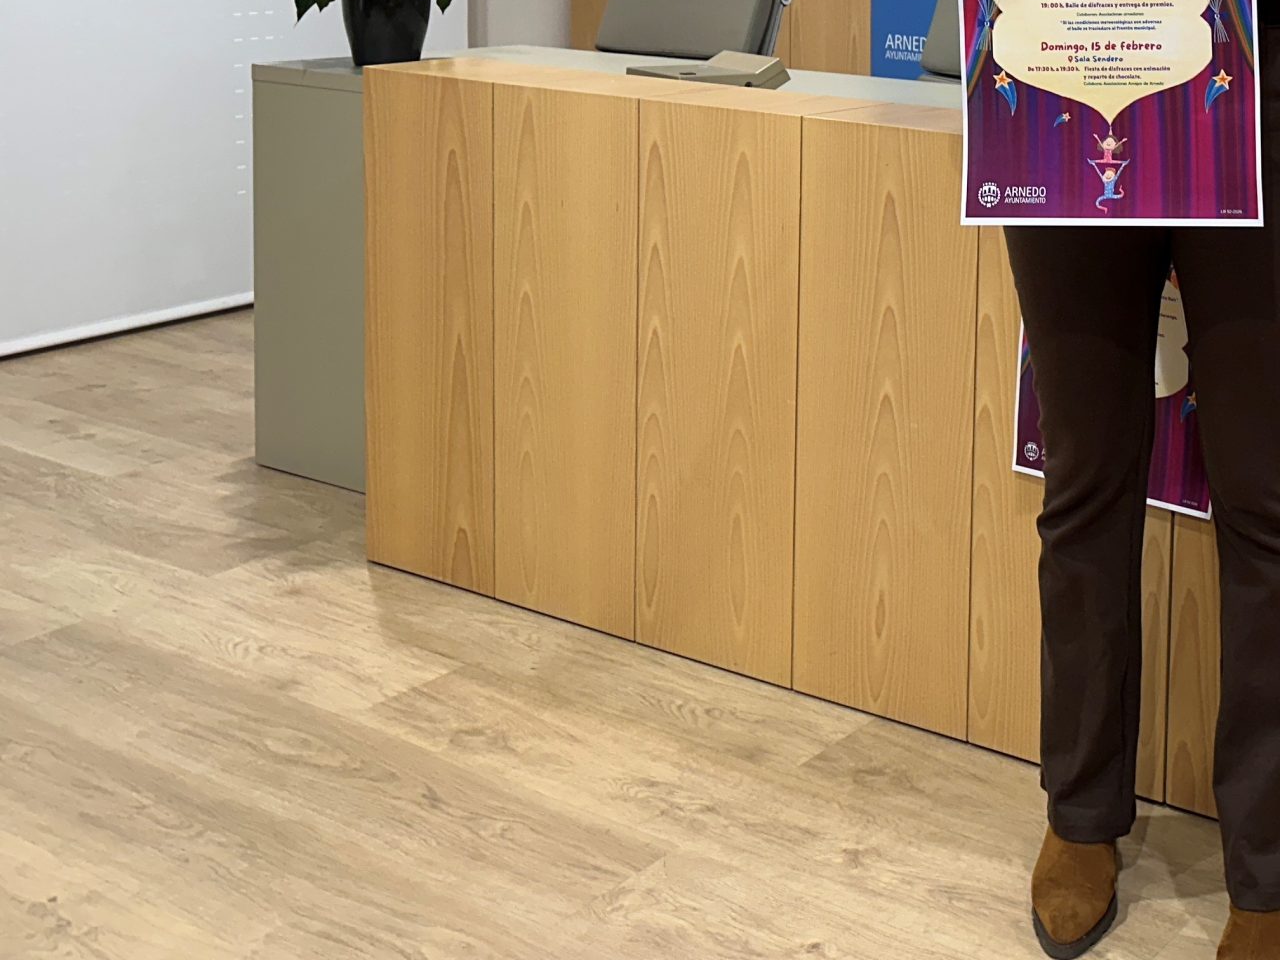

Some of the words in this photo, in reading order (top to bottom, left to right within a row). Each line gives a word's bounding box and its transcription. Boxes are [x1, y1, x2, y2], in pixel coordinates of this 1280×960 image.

[885, 33, 927, 52] ARNED
[1041, 41, 1088, 53] Domingo,
[1091, 42, 1101, 51] 15
[1104, 40, 1116, 50] de
[1120, 40, 1162, 51] febrero
[1004, 186, 1047, 197] ARNEDO
